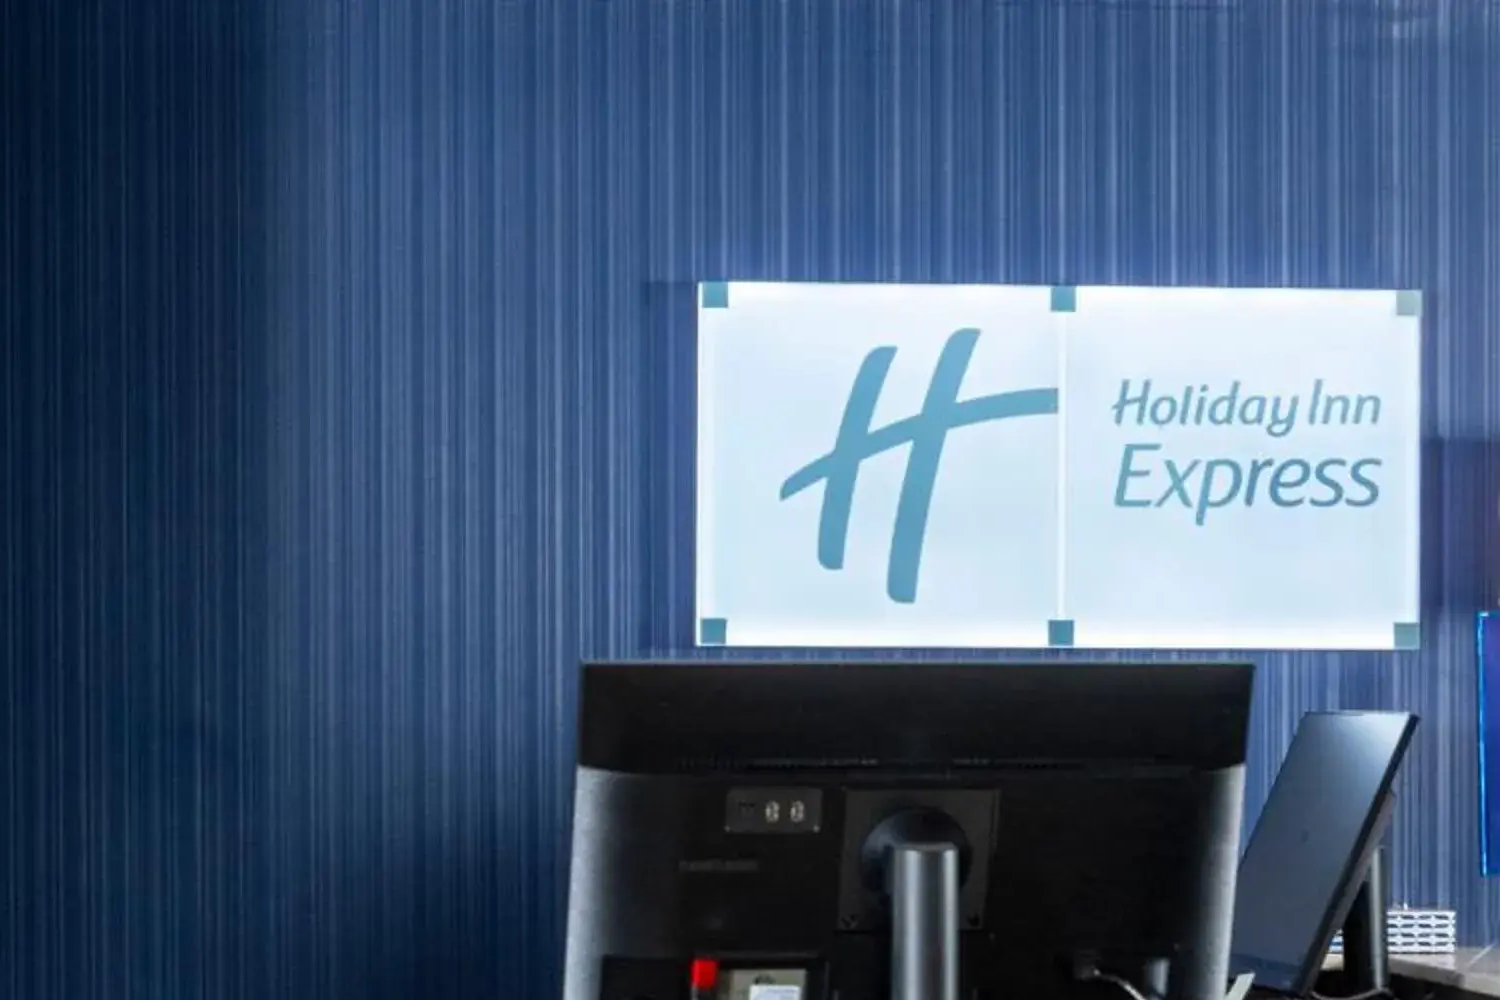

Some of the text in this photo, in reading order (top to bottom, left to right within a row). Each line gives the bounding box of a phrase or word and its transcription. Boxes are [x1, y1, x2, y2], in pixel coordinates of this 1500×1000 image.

[1111, 378, 1382, 438] Holiday Inn
[779, 327, 1059, 605] H
[1113, 443, 1383, 527] Express
